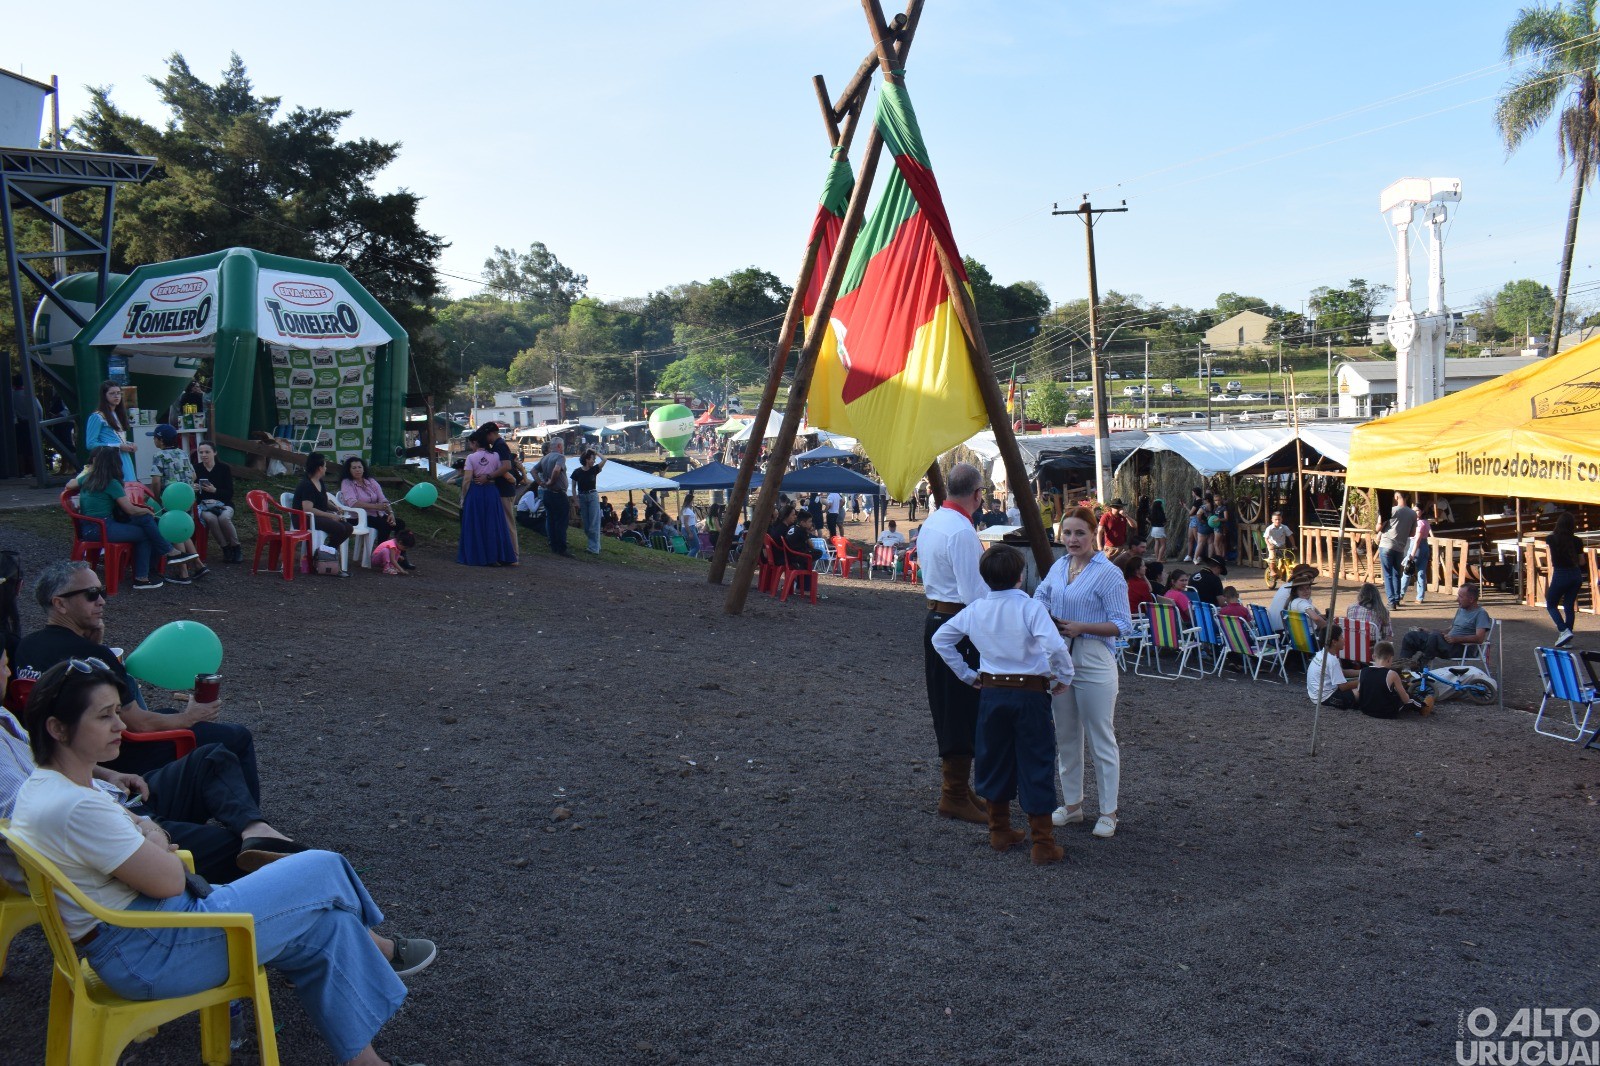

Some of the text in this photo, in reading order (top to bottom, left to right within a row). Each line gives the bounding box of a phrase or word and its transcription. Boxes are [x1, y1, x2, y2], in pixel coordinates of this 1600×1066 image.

[157, 282, 202, 296] ERVA-MATE
[279, 287, 327, 298] ERVA-MATE
[124, 294, 213, 337] TOMELERO
[265, 298, 360, 337] TOMELERO
[1573, 402, 1600, 412] BAR
[1577, 461, 1600, 483] co
